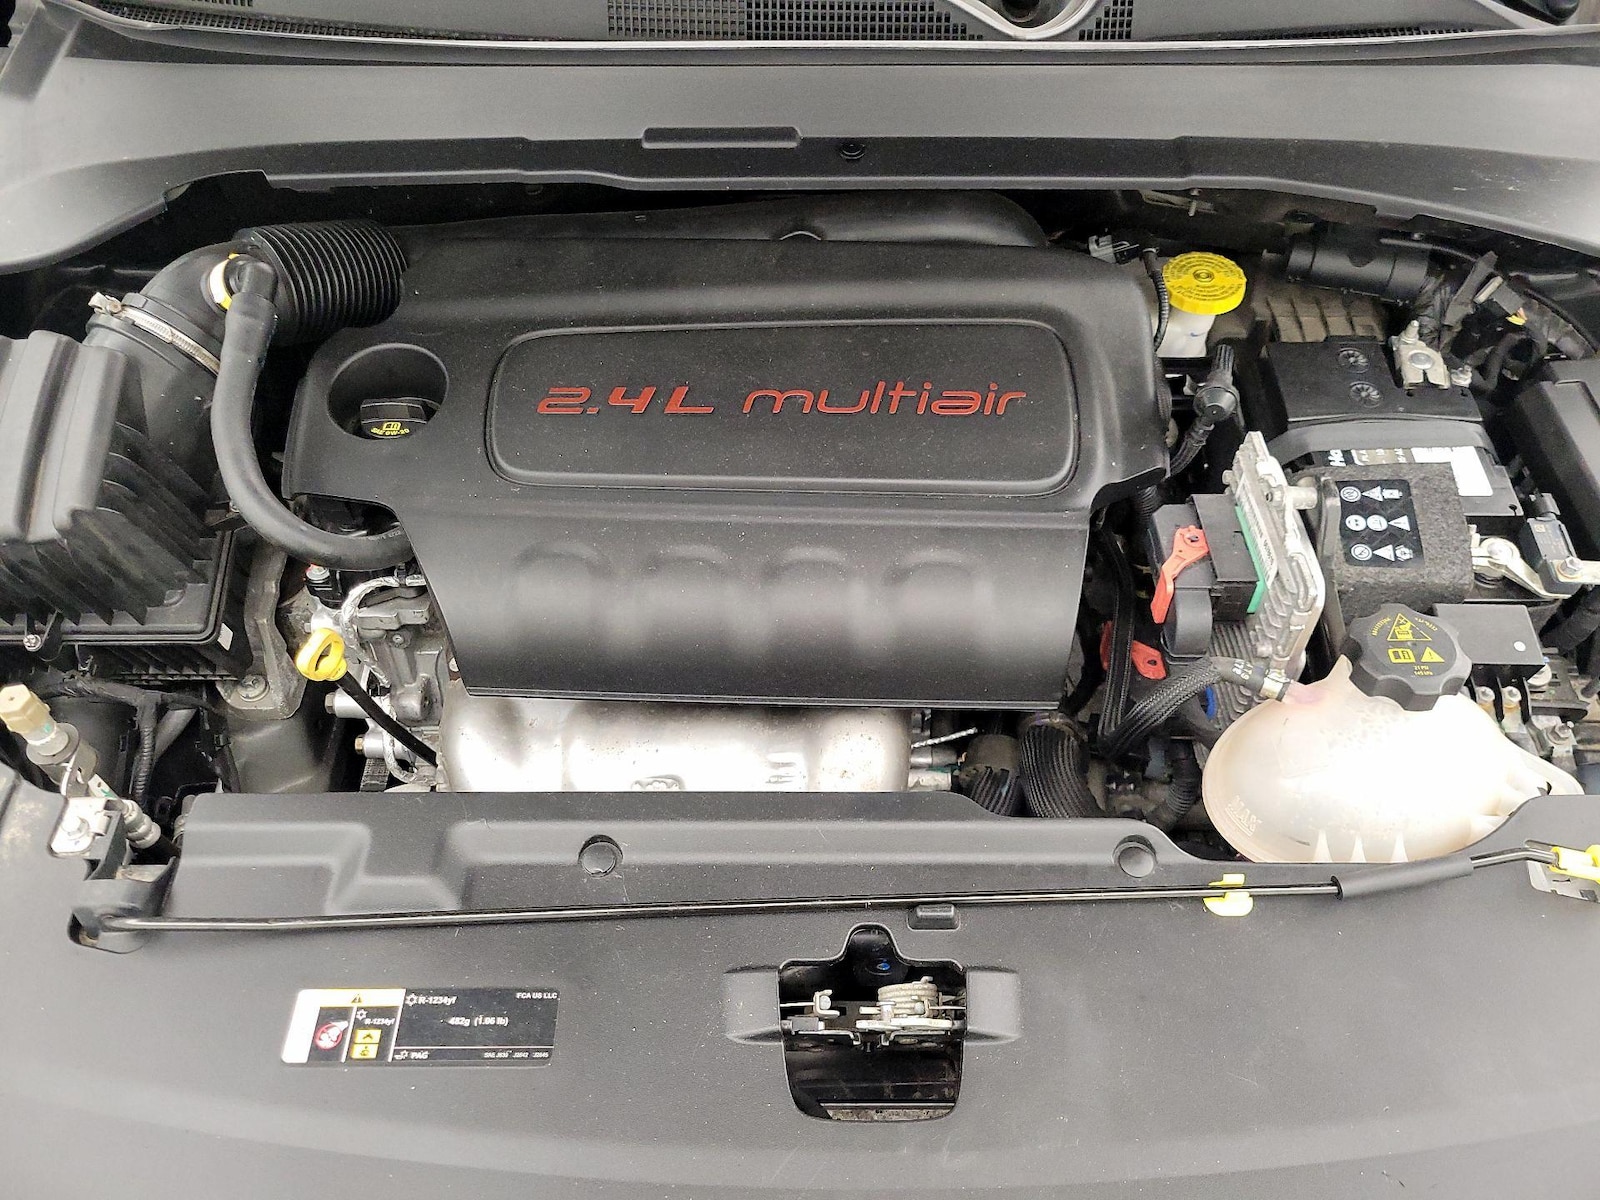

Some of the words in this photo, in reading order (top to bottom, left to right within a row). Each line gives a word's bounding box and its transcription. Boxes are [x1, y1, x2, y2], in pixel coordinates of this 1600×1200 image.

[742, 380, 1028, 416] multiair
[385, 427, 410, 436] 0W-20
[418, 995, 457, 1006] R-1234yf
